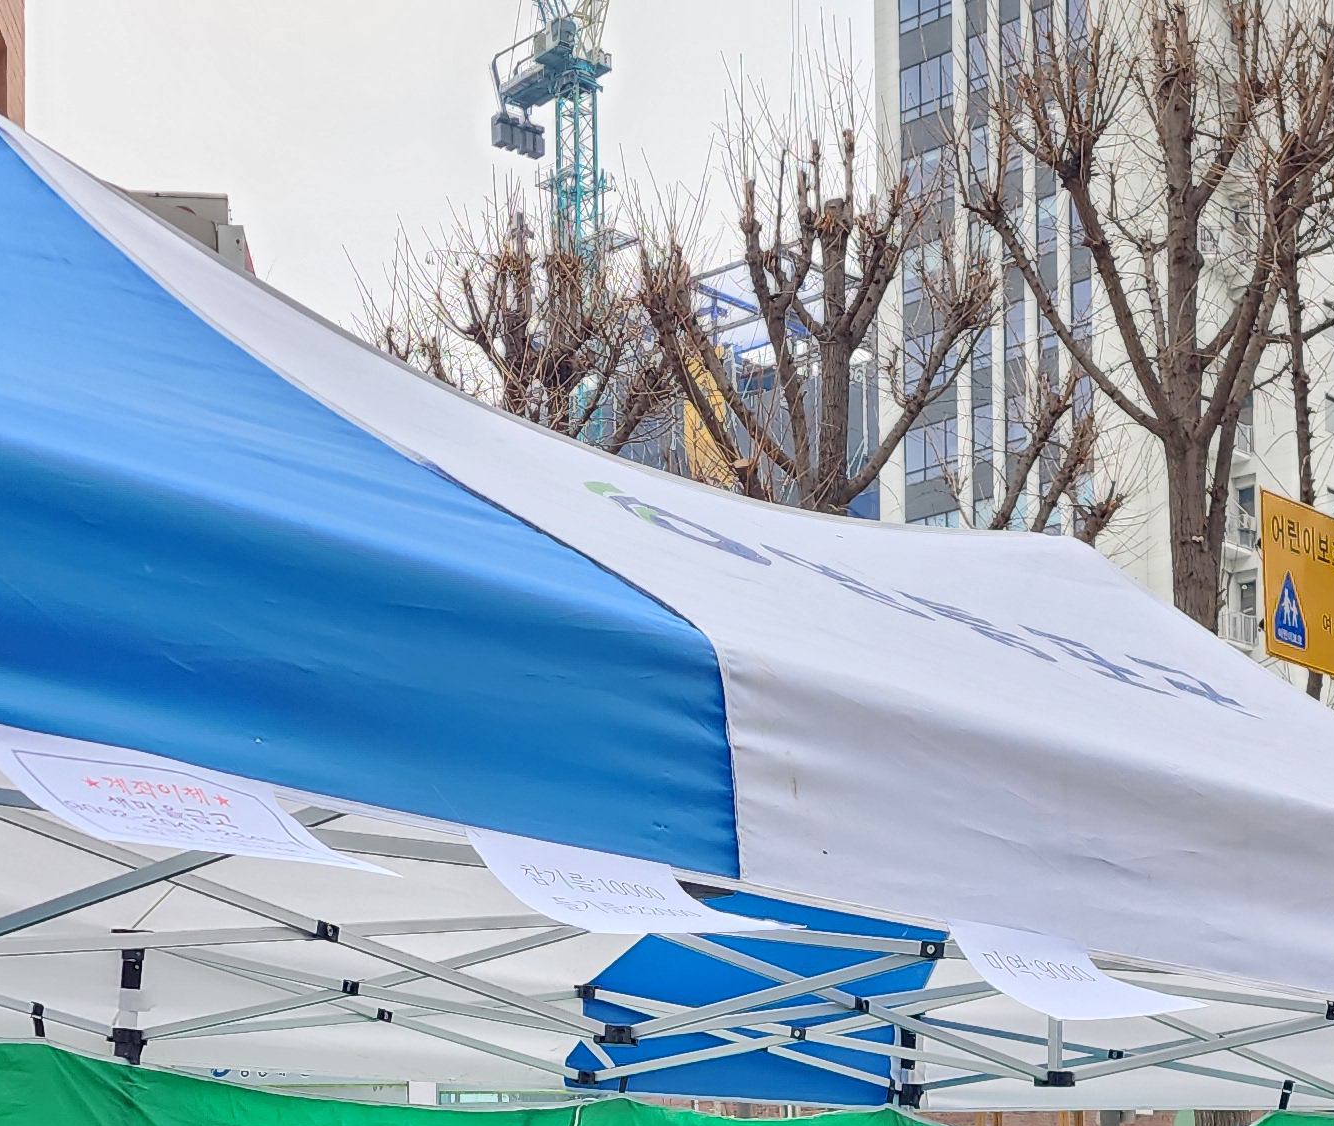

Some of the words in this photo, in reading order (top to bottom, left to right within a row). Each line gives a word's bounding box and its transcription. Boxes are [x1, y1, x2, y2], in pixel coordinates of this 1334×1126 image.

[101, 776, 212, 807] 계좌이체
[107, 796, 240, 830] 새마을금고
[520, 863, 666, 901] 참기름:10000
[982, 950, 1097, 981] 미역:9000
